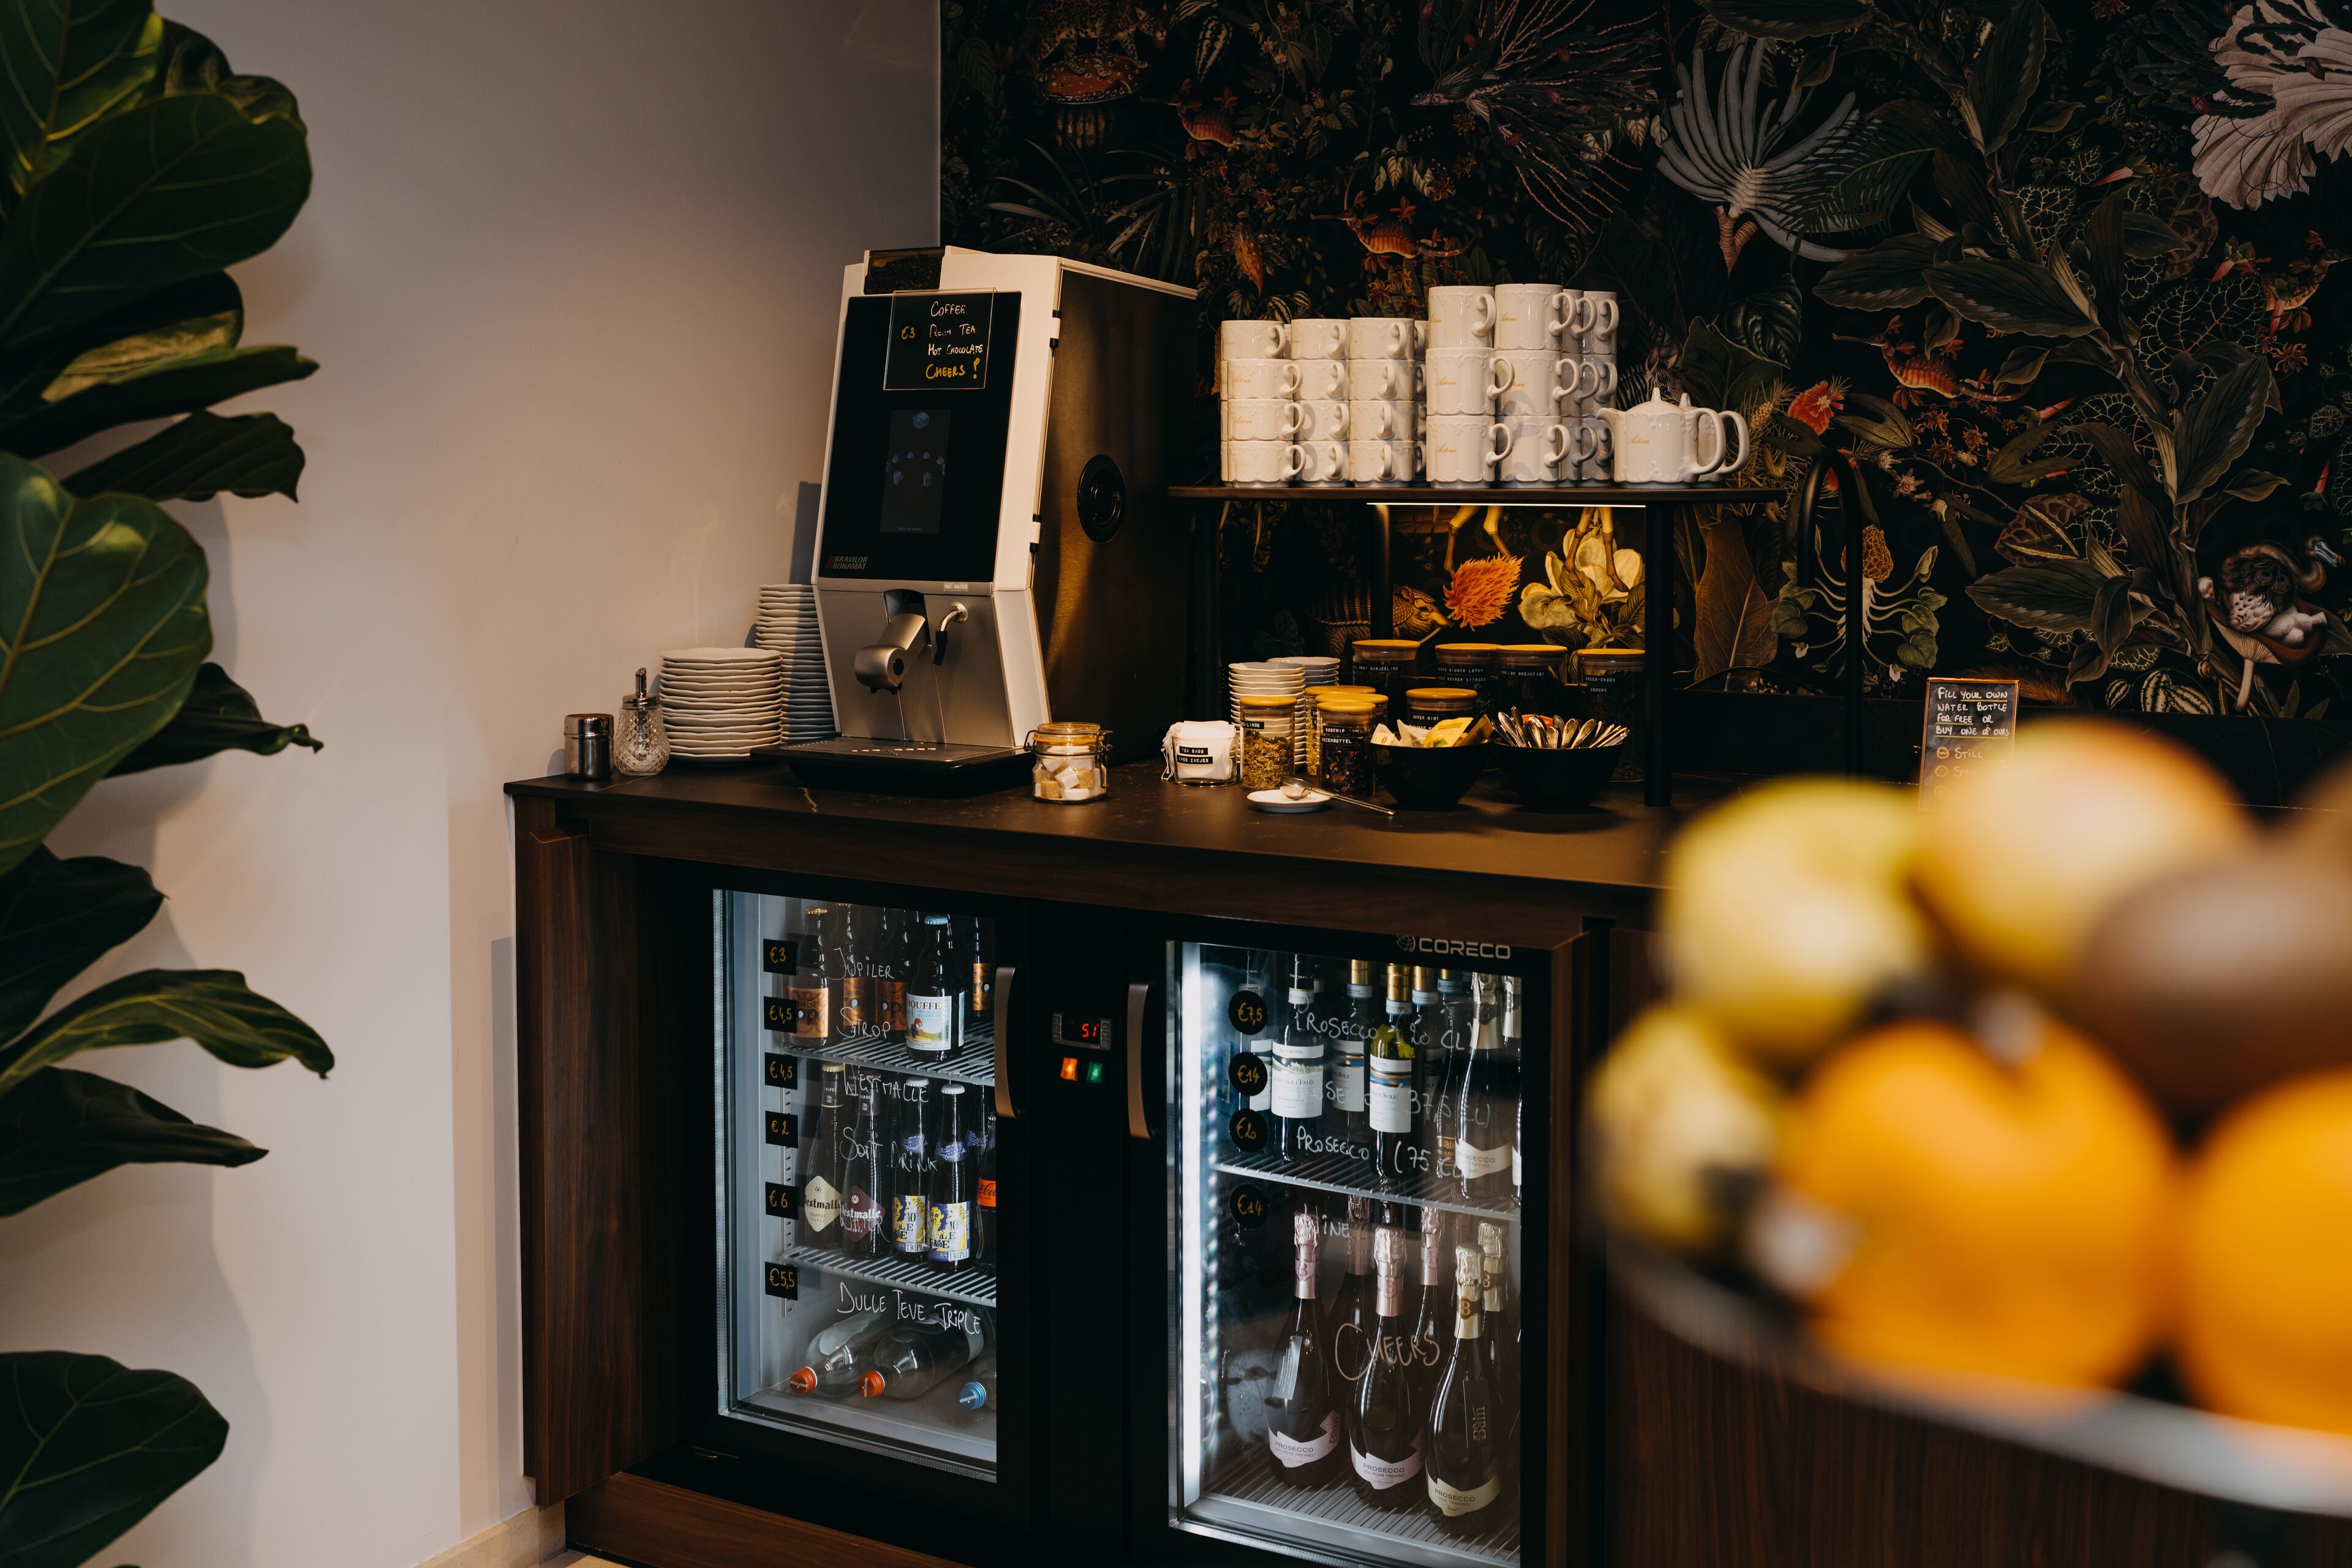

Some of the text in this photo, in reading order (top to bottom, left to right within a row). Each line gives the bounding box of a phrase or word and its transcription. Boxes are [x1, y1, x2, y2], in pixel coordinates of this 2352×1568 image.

[930, 301, 966, 317] COFFEE
[901, 326, 916, 339] €3
[959, 323, 975, 335] TEA
[928, 343, 983, 355] HOT CHOCOLATE
[925, 364, 965, 379] CHEERS
[1977, 702, 2007, 712] BOTTLE
[1937, 713, 1951, 722] FOR
[1954, 715, 1972, 723] FREE
[1936, 725, 1953, 735] BUY
[1982, 727, 1991, 736] OF
[1954, 747, 1983, 759] STILL
[769, 946, 786, 963] €3
[1419, 938, 1510, 959] CORECO
[797, 1000, 817, 1008] EBELSE
[837, 1006, 891, 1039] STROP
[1237, 1065, 1259, 1084] €14
[843, 1063, 929, 1102] WESTMALLE
[840, 1127, 883, 1160] SOFT
[1297, 1125, 1370, 1159] PROSECCO
[1237, 1194, 1263, 1216] €14
[837, 1281, 886, 1313] DULLE
[892, 1289, 925, 1319] TEVE
[1335, 1323, 1440, 1381] CHEERS
[1275, 1441, 1314, 1452] PROSECCO
[1363, 1463, 1404, 1473] PROSECCO
[1434, 1488, 1475, 1502] PROSECCO
